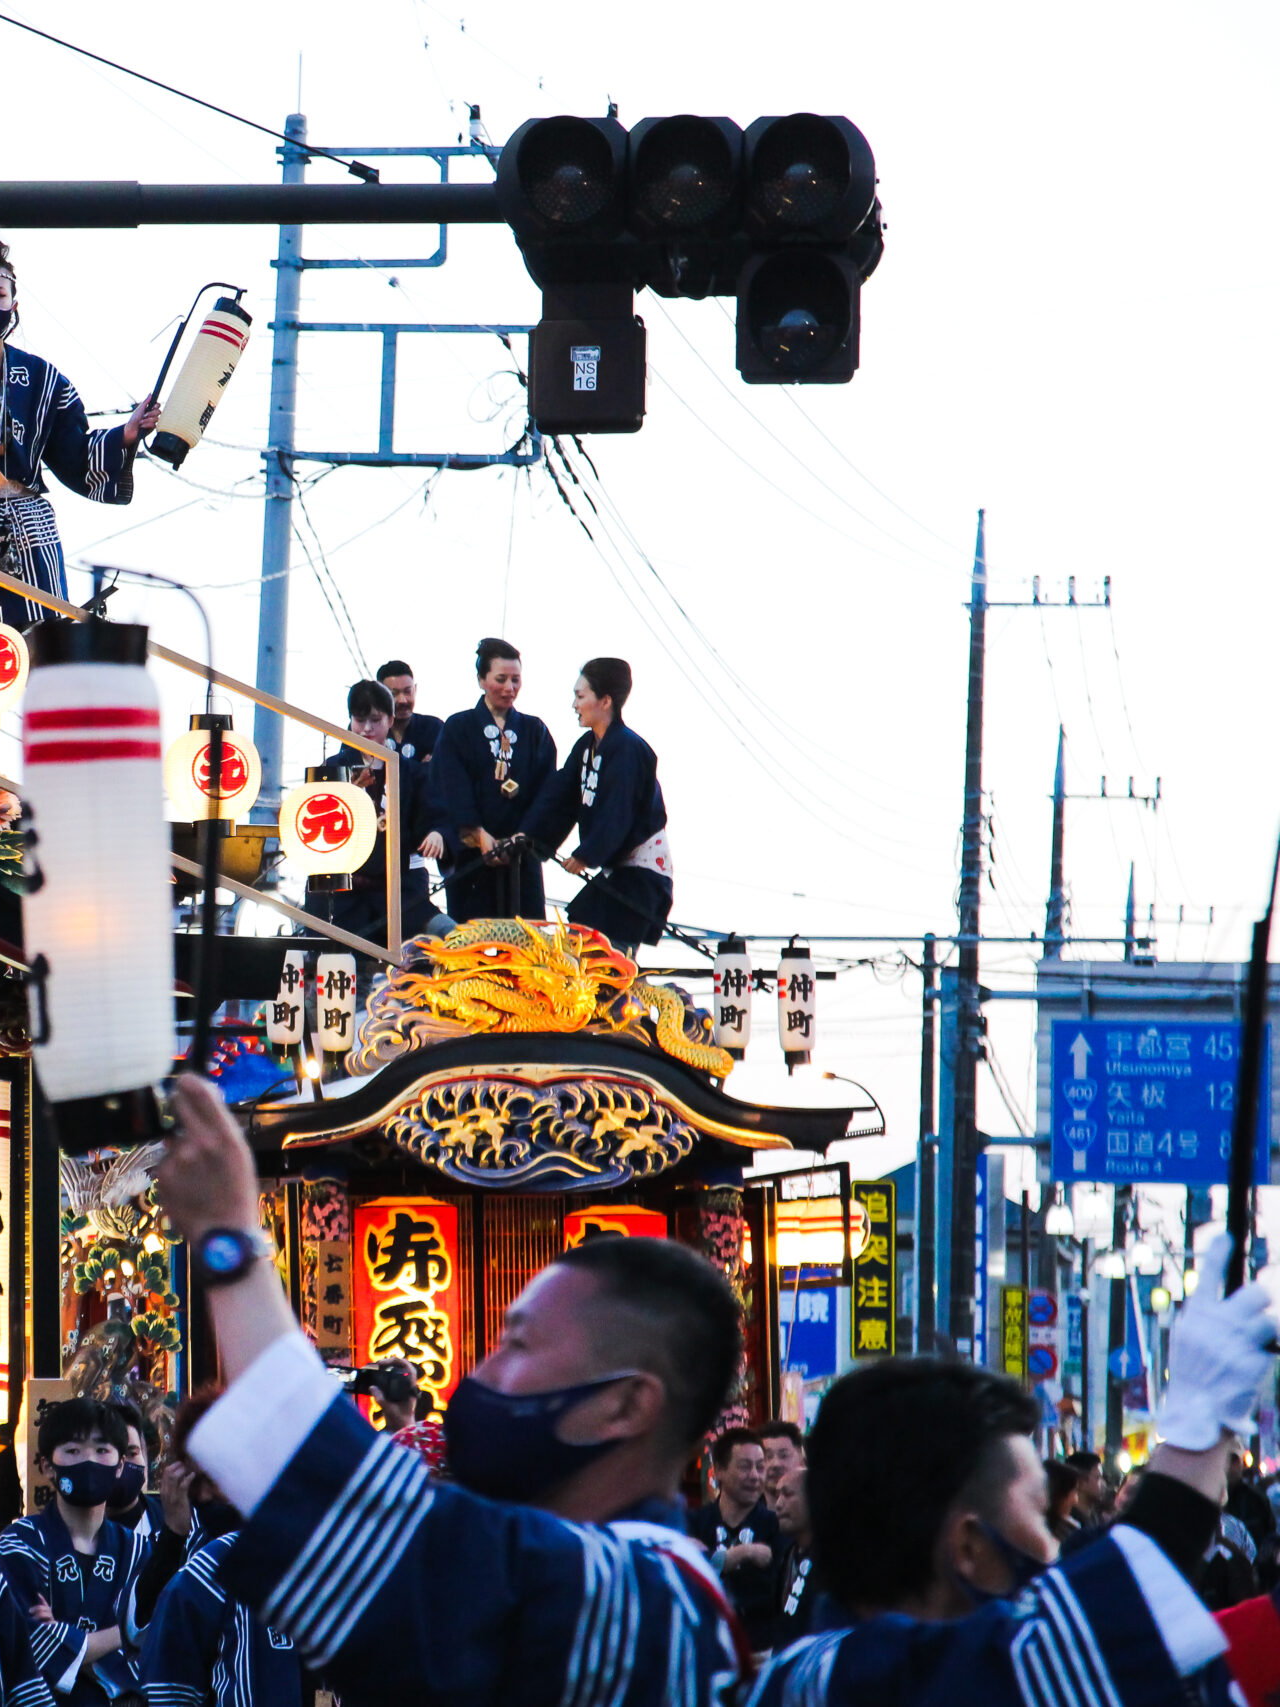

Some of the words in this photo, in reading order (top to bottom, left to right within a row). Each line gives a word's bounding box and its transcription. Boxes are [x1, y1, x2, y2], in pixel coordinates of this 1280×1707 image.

[575, 363, 596, 375] NS
[575, 377, 596, 389] 16
[298, 793, 352, 850] 元
[323, 970, 352, 1038] 仲町
[720, 968, 748, 1033] 仲町
[786, 973, 814, 1038] 仲町
[1203, 1031, 1234, 1061] 45
[1105, 1060, 1193, 1079] Utsunomiya
[1068, 1086, 1093, 1101] 400
[1206, 1081, 1234, 1111] 12
[1068, 1126, 1091, 1141] 461
[56, 1554, 80, 1583] 元
[93, 1554, 116, 1582] 元
